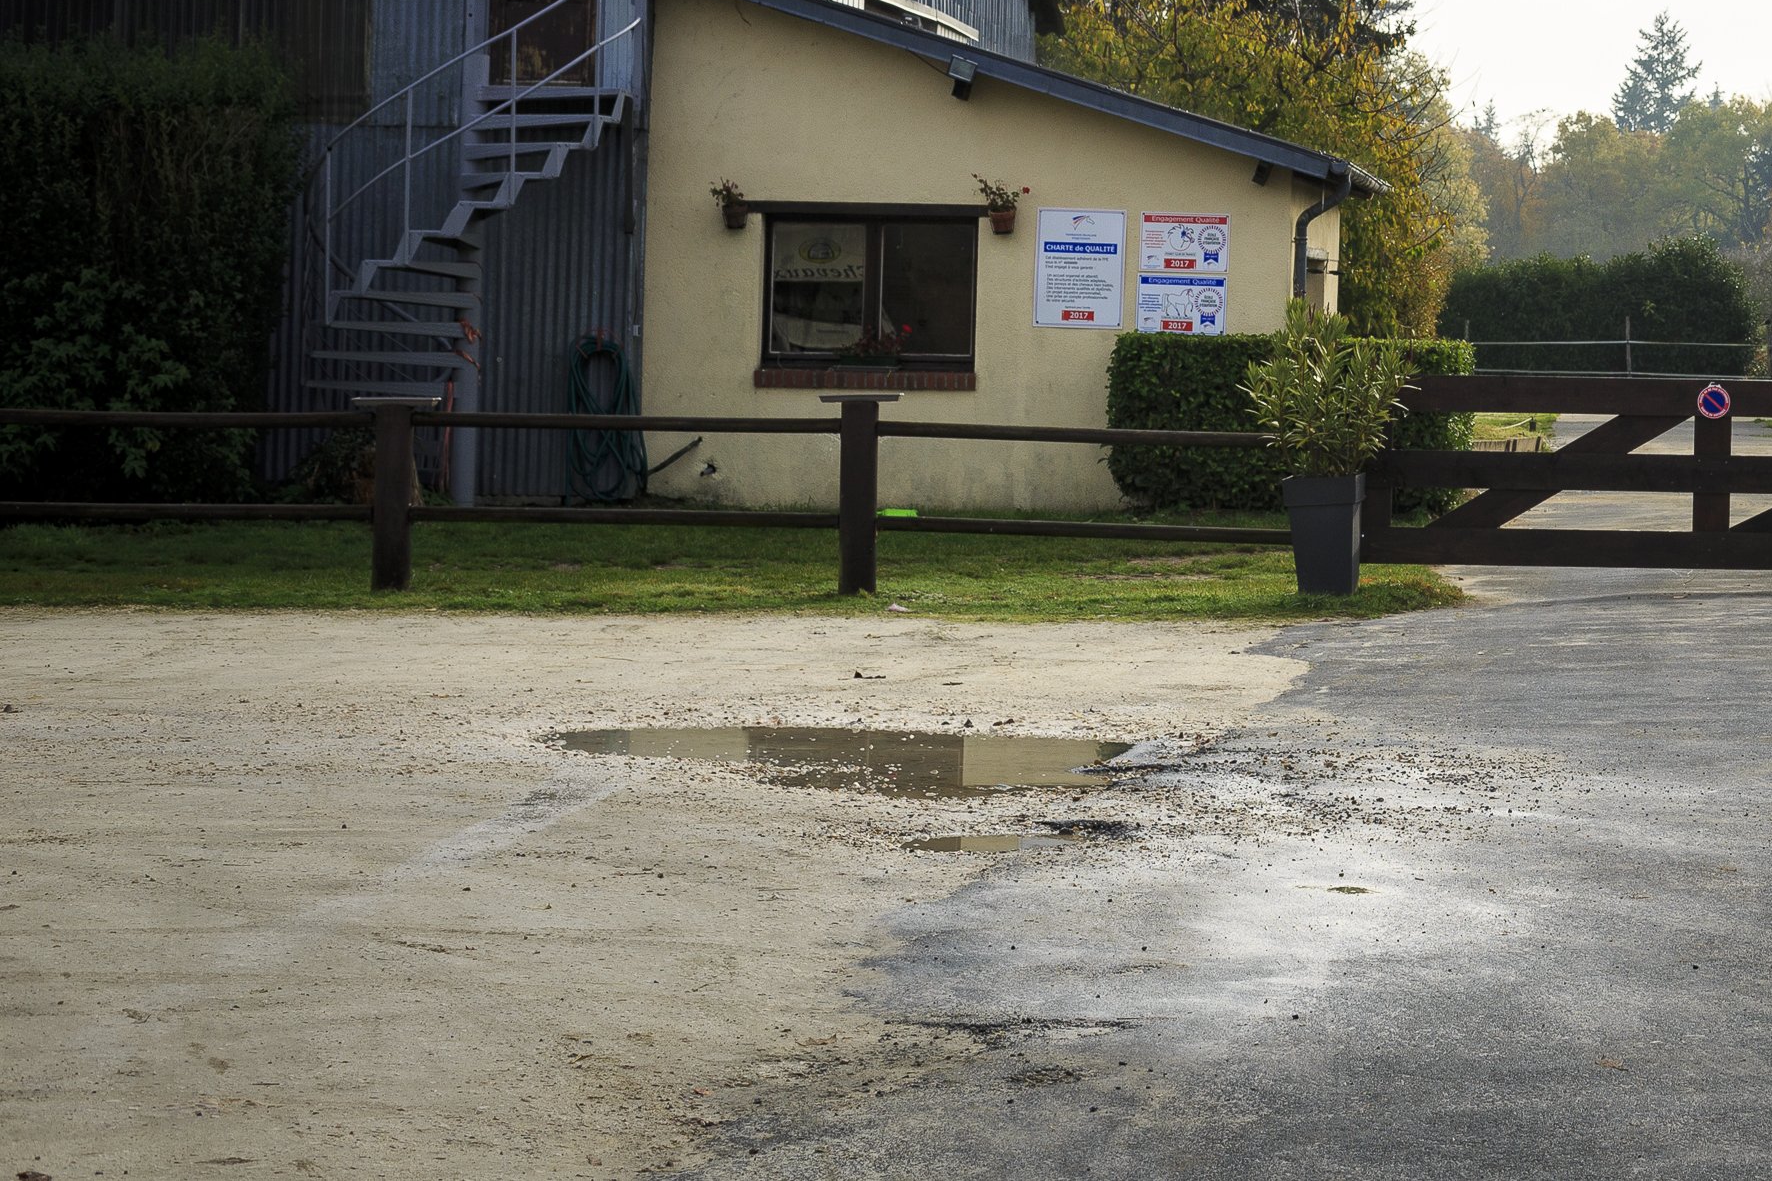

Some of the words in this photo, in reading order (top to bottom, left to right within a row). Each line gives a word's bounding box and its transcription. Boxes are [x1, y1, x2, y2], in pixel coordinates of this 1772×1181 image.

[1046, 244, 1074, 252] CHARTE
[1084, 244, 1115, 253] QUALITÉ
[1170, 260, 1189, 268] 2017
[1069, 311, 1089, 319] 2017
[1168, 322, 1187, 330] 2017
